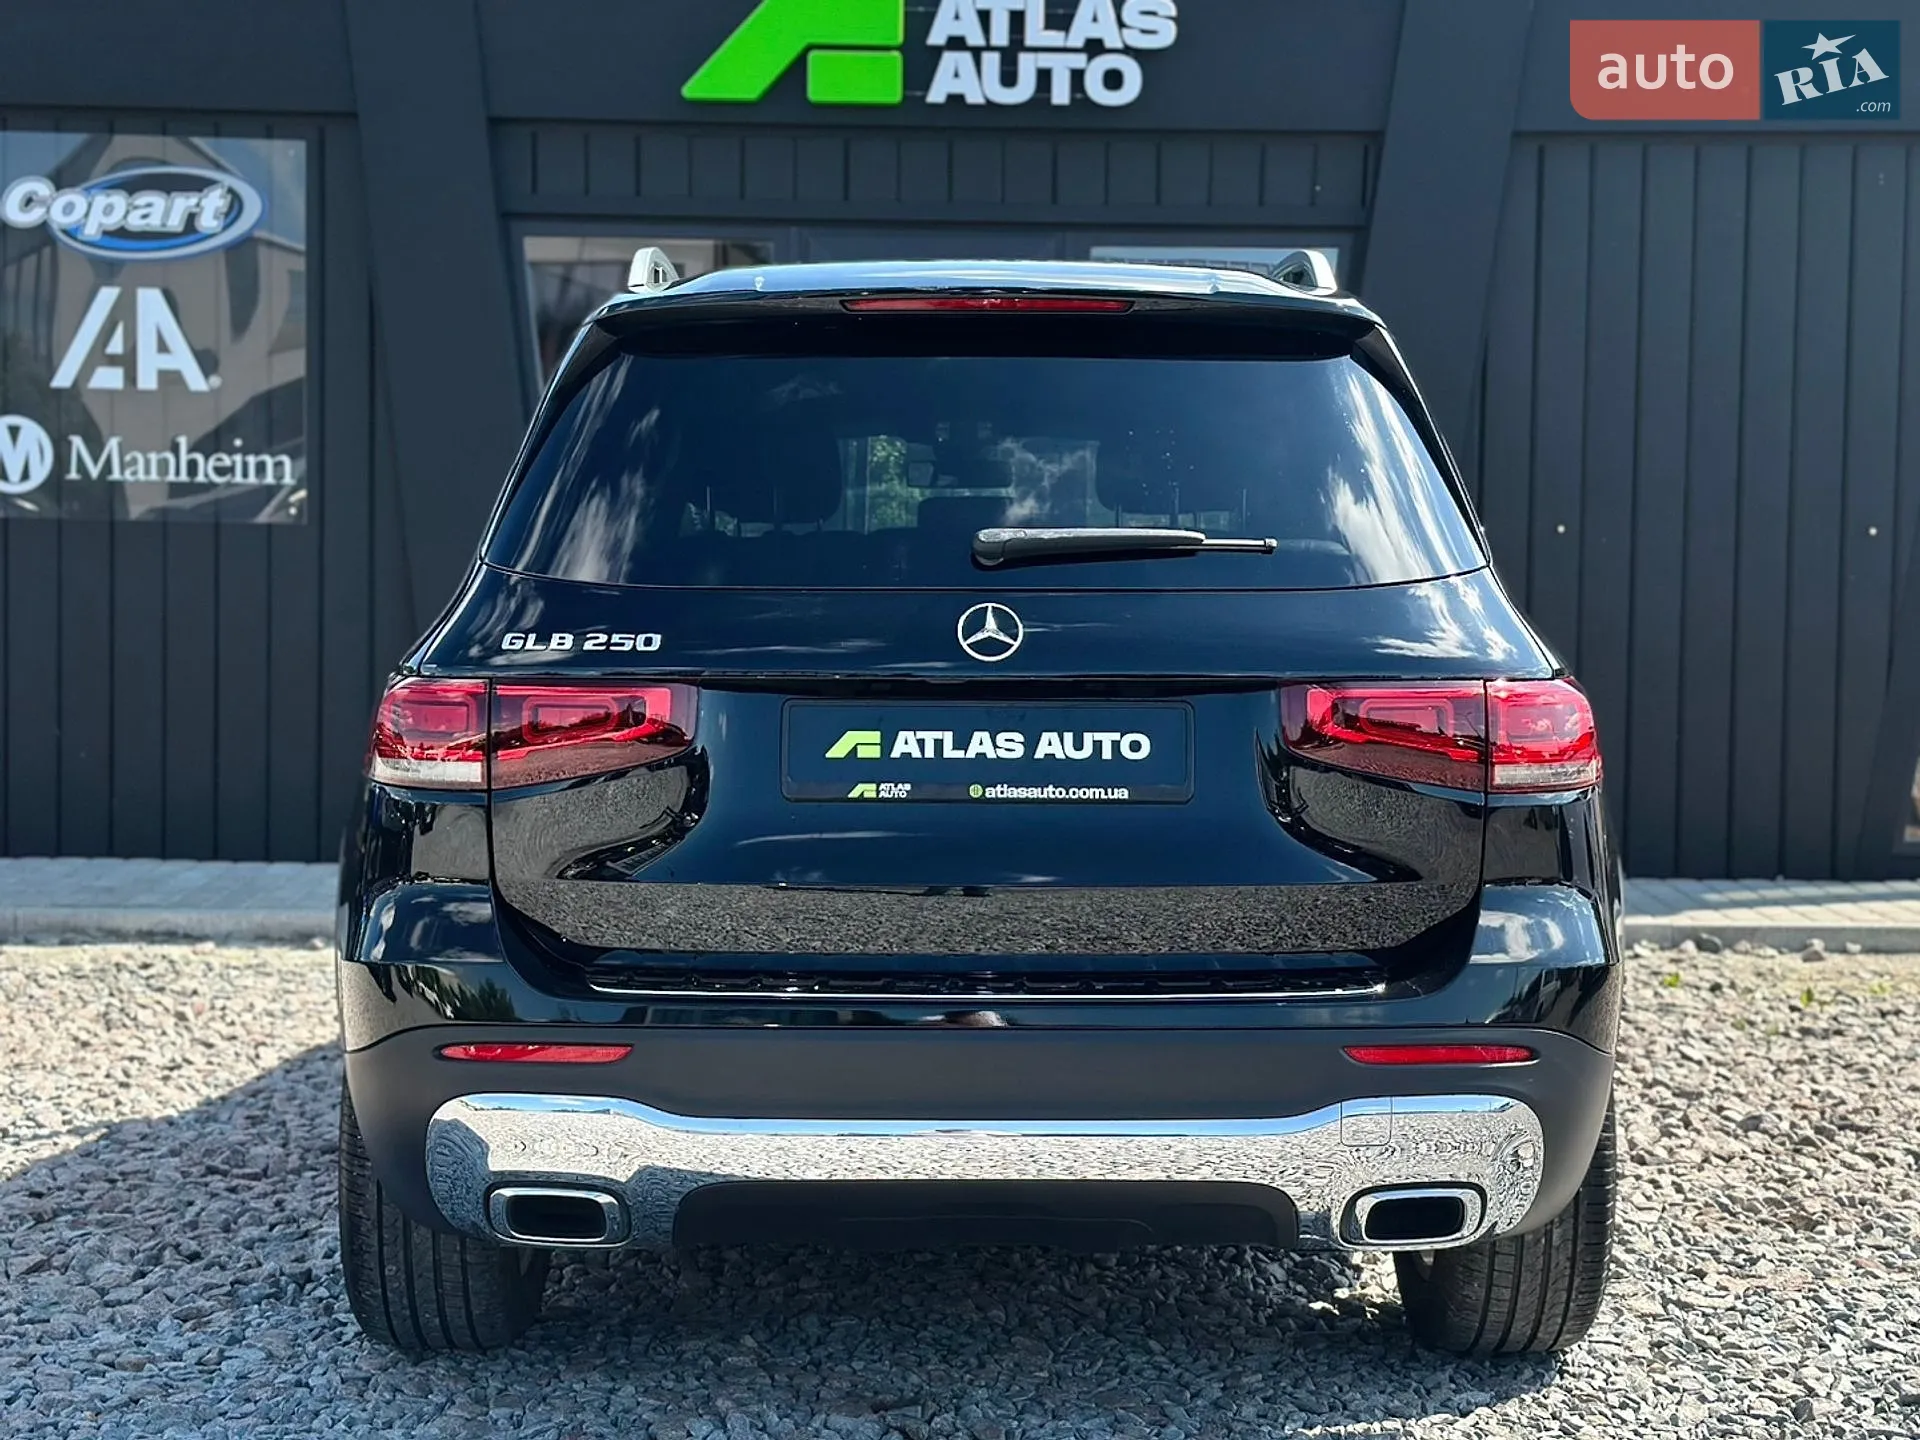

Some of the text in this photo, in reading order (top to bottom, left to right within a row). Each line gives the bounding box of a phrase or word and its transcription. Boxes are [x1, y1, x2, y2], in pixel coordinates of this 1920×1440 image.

[926, 0, 1177, 48] ATLAS
[926, 51, 1143, 106] AUTO
[0, 175, 232, 241] Copart
[65, 434, 297, 486] Manheim
[501, 632, 662, 651] GLB 250
[890, 731, 1151, 760] ATLAS AUTO
[985, 784, 1129, 800] atlasauto.com.ua
